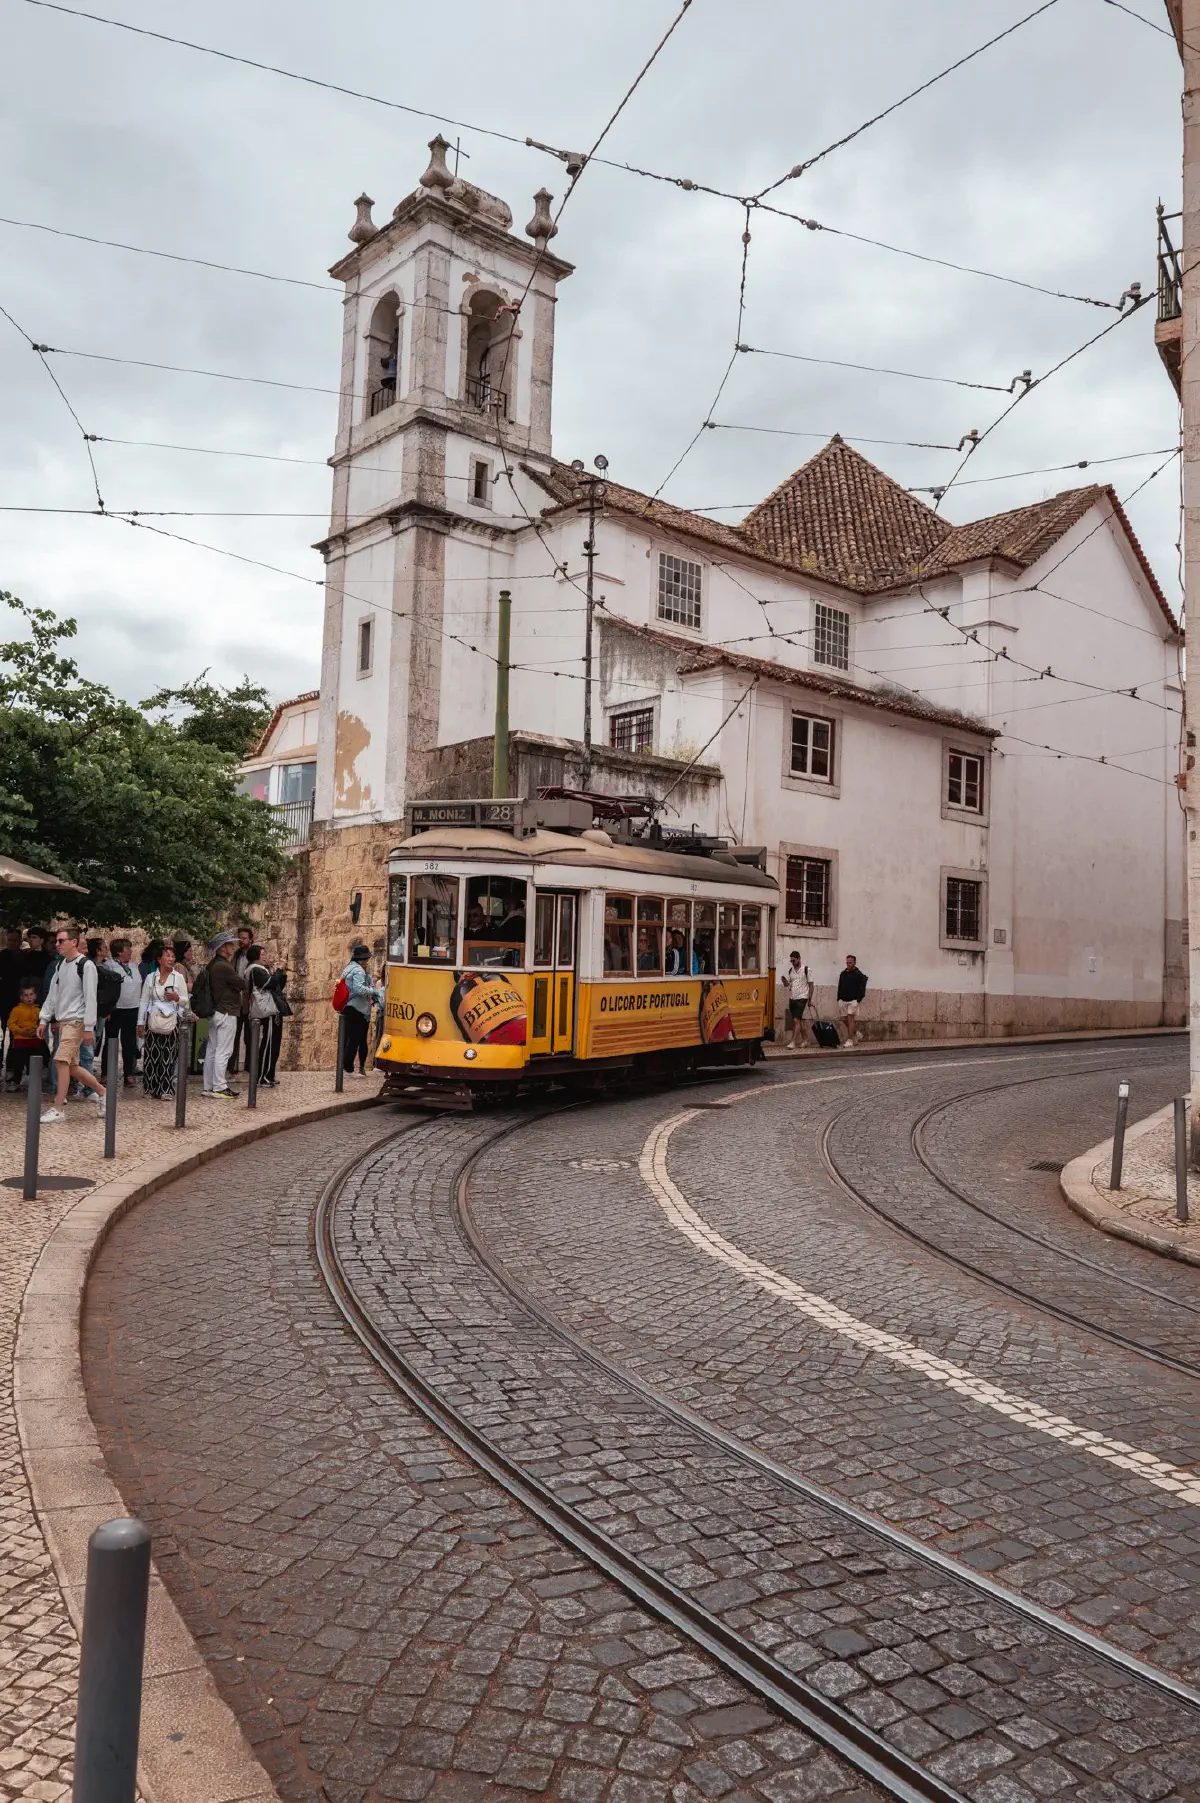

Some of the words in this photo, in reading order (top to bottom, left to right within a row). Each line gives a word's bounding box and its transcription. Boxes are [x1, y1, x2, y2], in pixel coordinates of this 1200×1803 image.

[415, 810, 426, 820] M.
[429, 809, 466, 820] MONIZ
[490, 805, 511, 820] 28
[424, 863, 439, 871] 582
[600, 996, 607, 1012] O
[609, 995, 635, 1012] LICOR
[636, 994, 648, 1010] DE
[649, 992, 690, 1009] PORTUGAL
[386, 1001, 415, 1020] EIRÃO
